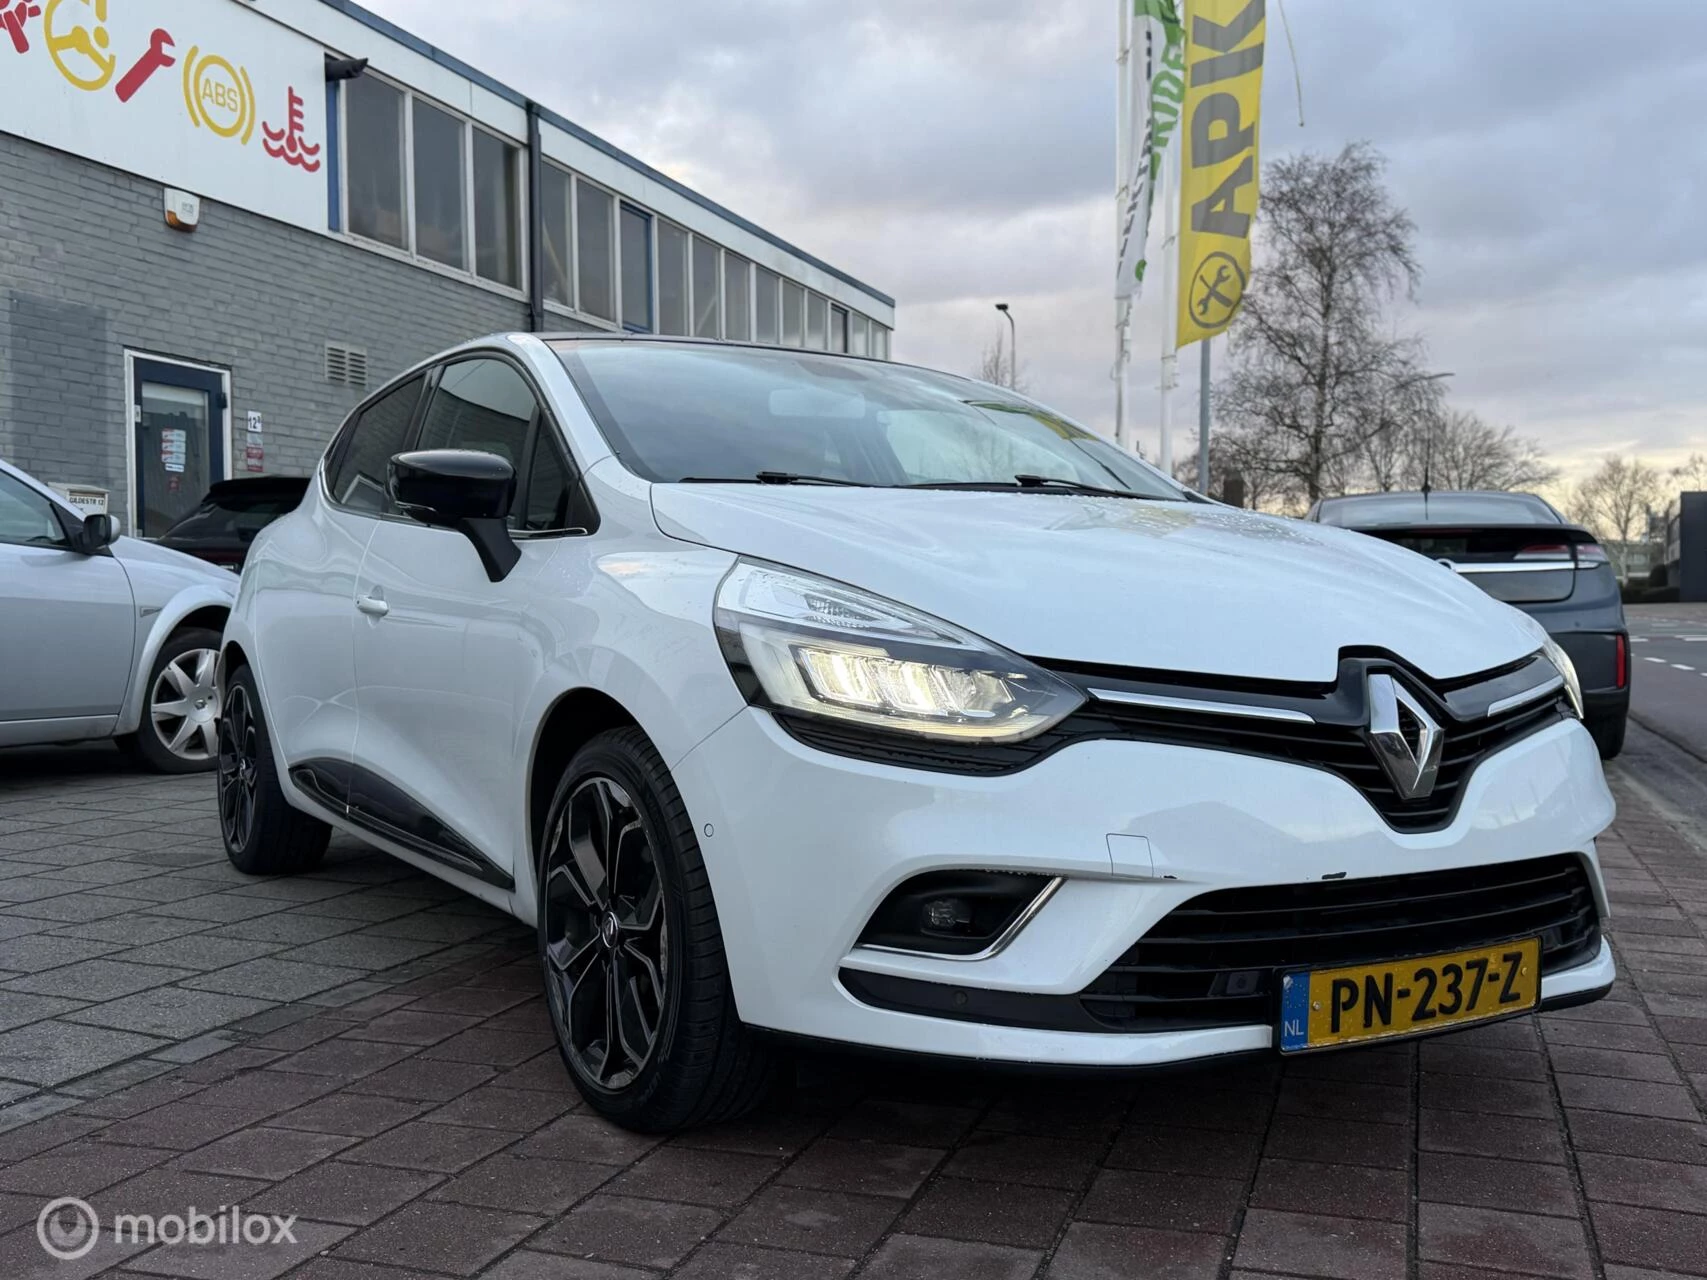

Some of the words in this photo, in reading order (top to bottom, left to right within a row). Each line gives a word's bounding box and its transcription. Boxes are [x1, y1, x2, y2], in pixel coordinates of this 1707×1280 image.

[202, 78, 238, 112] ABS
[1190, 0, 1265, 239] APK
[1284, 1020, 1304, 1036] NL
[1330, 951, 1523, 1033] PN-237-Z
